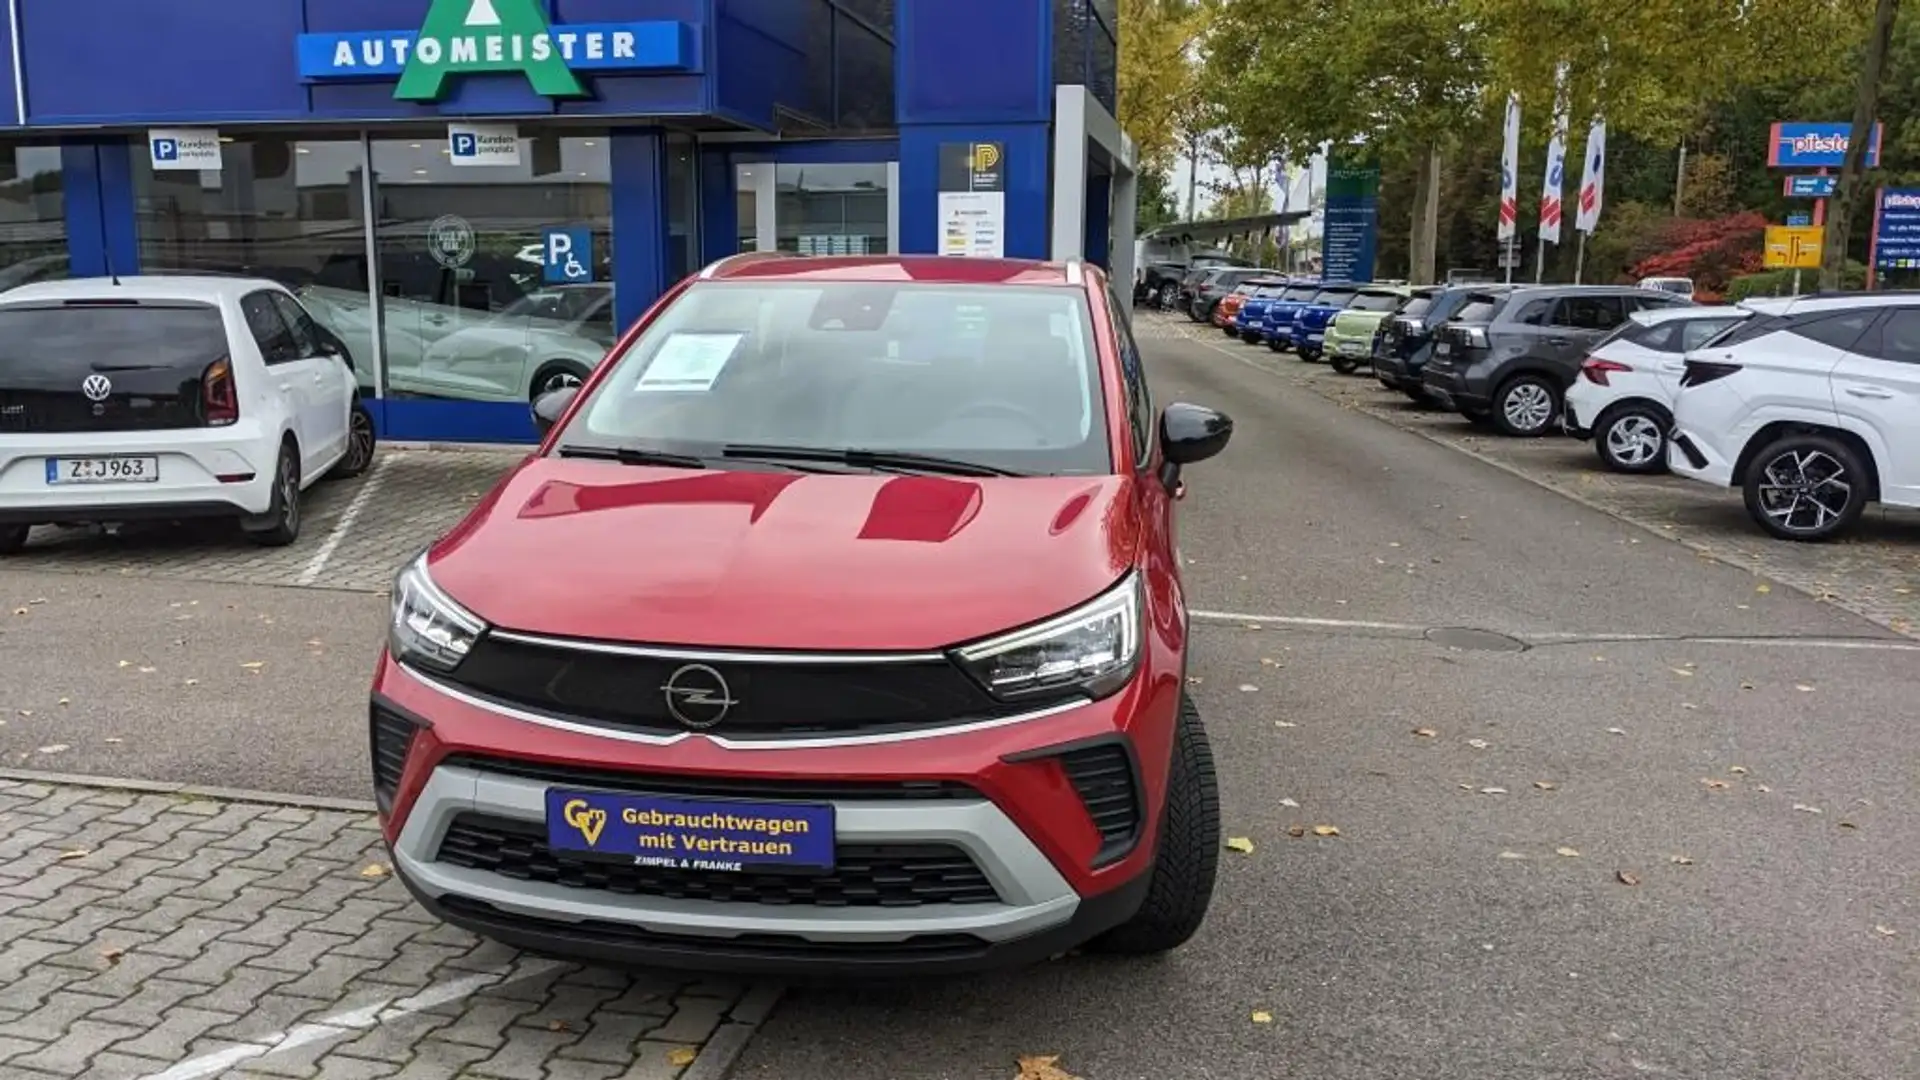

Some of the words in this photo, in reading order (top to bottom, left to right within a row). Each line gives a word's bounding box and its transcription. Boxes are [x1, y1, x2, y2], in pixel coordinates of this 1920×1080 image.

[333, 31, 636, 67] AUTOMEISTER
[549, 233, 572, 265] P
[622, 807, 809, 834] Gebrauchtwagen
[639, 833, 676, 850] mit
[681, 833, 793, 856] Vertrauen
[634, 855, 678, 868] ZIMPEL
[680, 858, 690, 868] &
[693, 860, 743, 872] FRANKE
